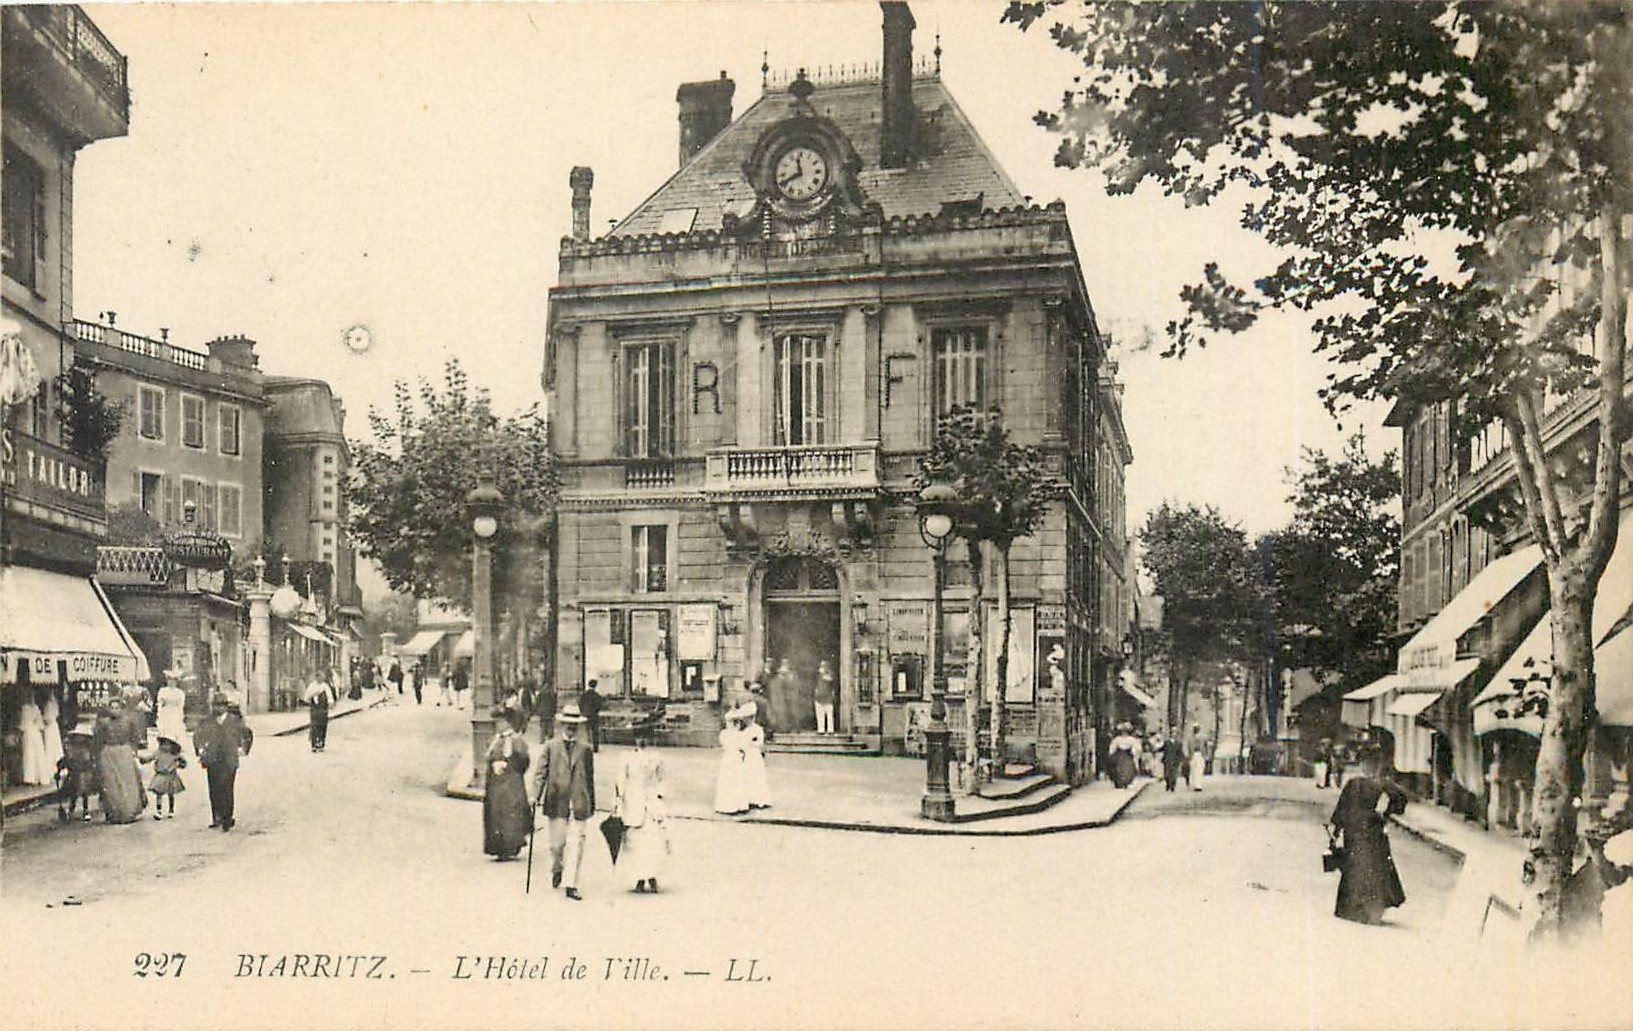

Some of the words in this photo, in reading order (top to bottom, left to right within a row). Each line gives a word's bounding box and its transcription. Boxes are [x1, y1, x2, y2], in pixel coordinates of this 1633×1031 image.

[692, 360, 723, 415] R
[884, 352, 917, 411] F
[26, 449, 89, 497] TAILOR
[165, 546, 229, 559] STAURANT
[35, 658, 52, 674] DE
[73, 657, 119, 674] COIFFURE
